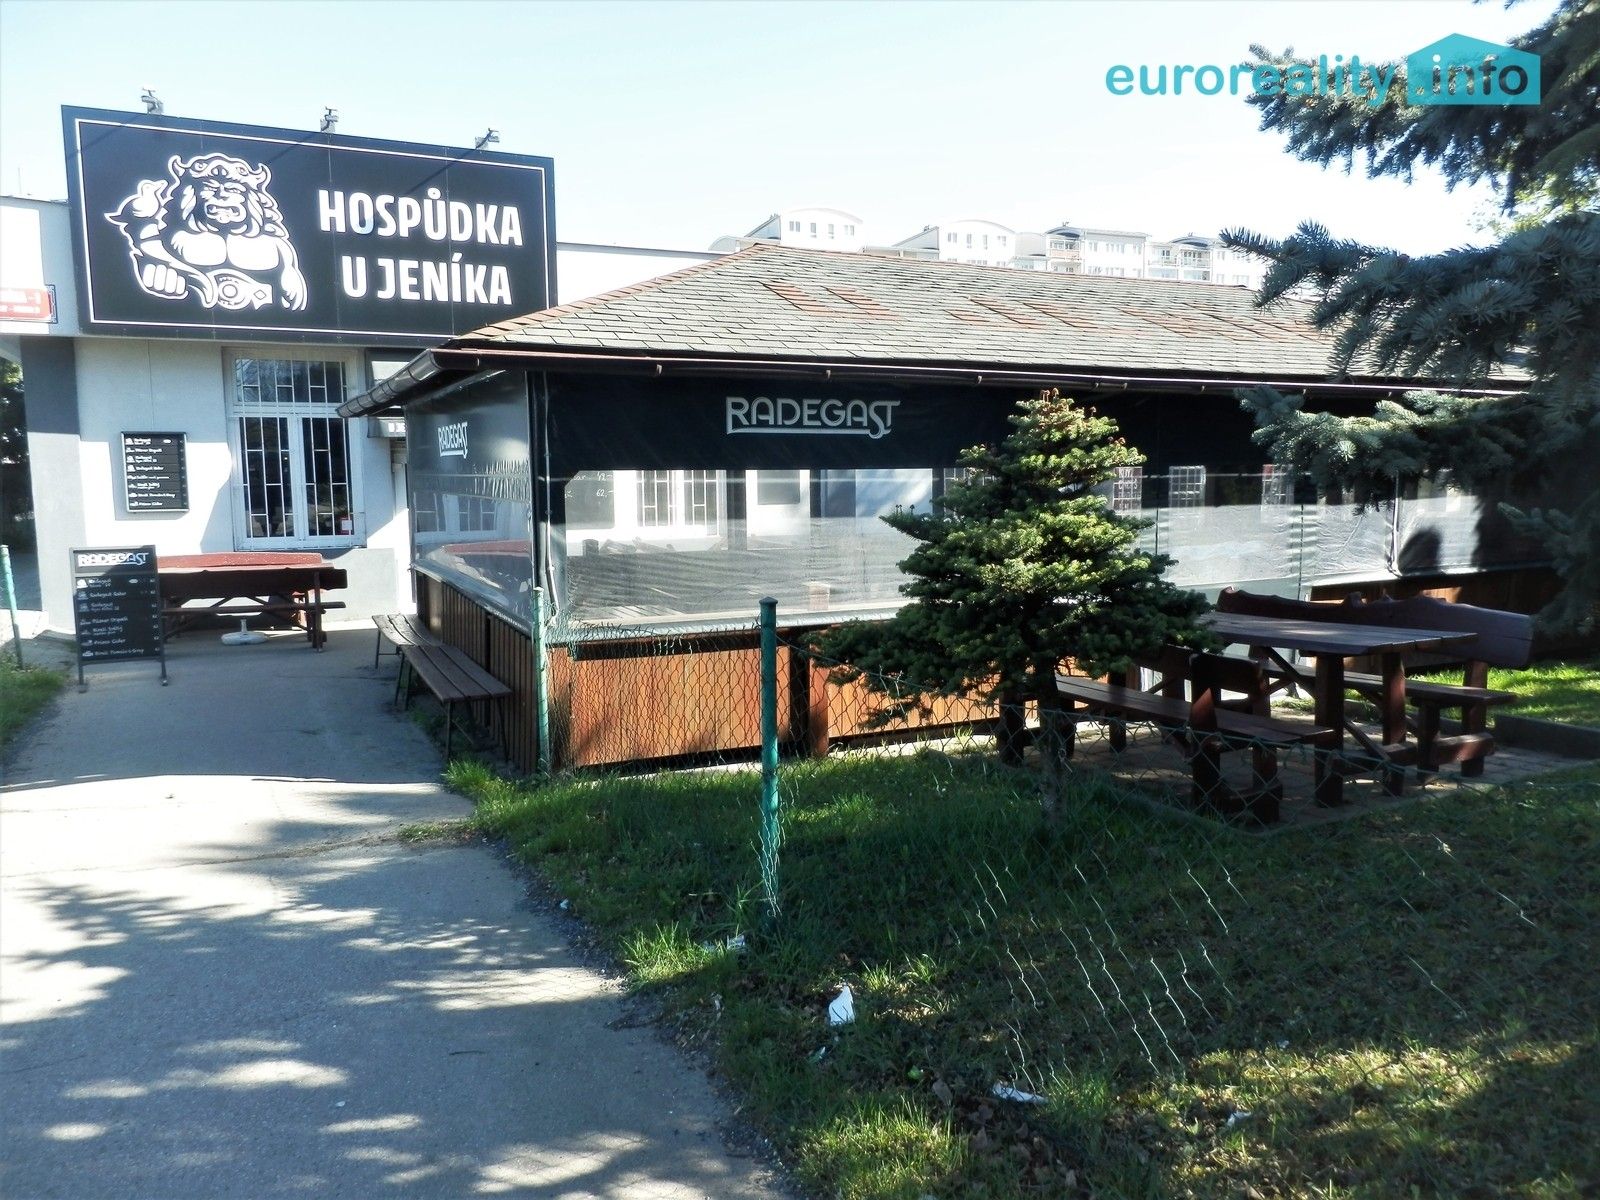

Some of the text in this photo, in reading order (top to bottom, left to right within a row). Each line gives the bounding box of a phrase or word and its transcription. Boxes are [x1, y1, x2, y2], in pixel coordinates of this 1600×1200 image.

[318, 187, 523, 246] HOSPŮDKA
[342, 252, 512, 304] U JENÍKA
[726, 396, 901, 439] RADEGAST
[437, 421, 468, 459] RADEGAST
[77, 552, 149, 567] RADEGAST
